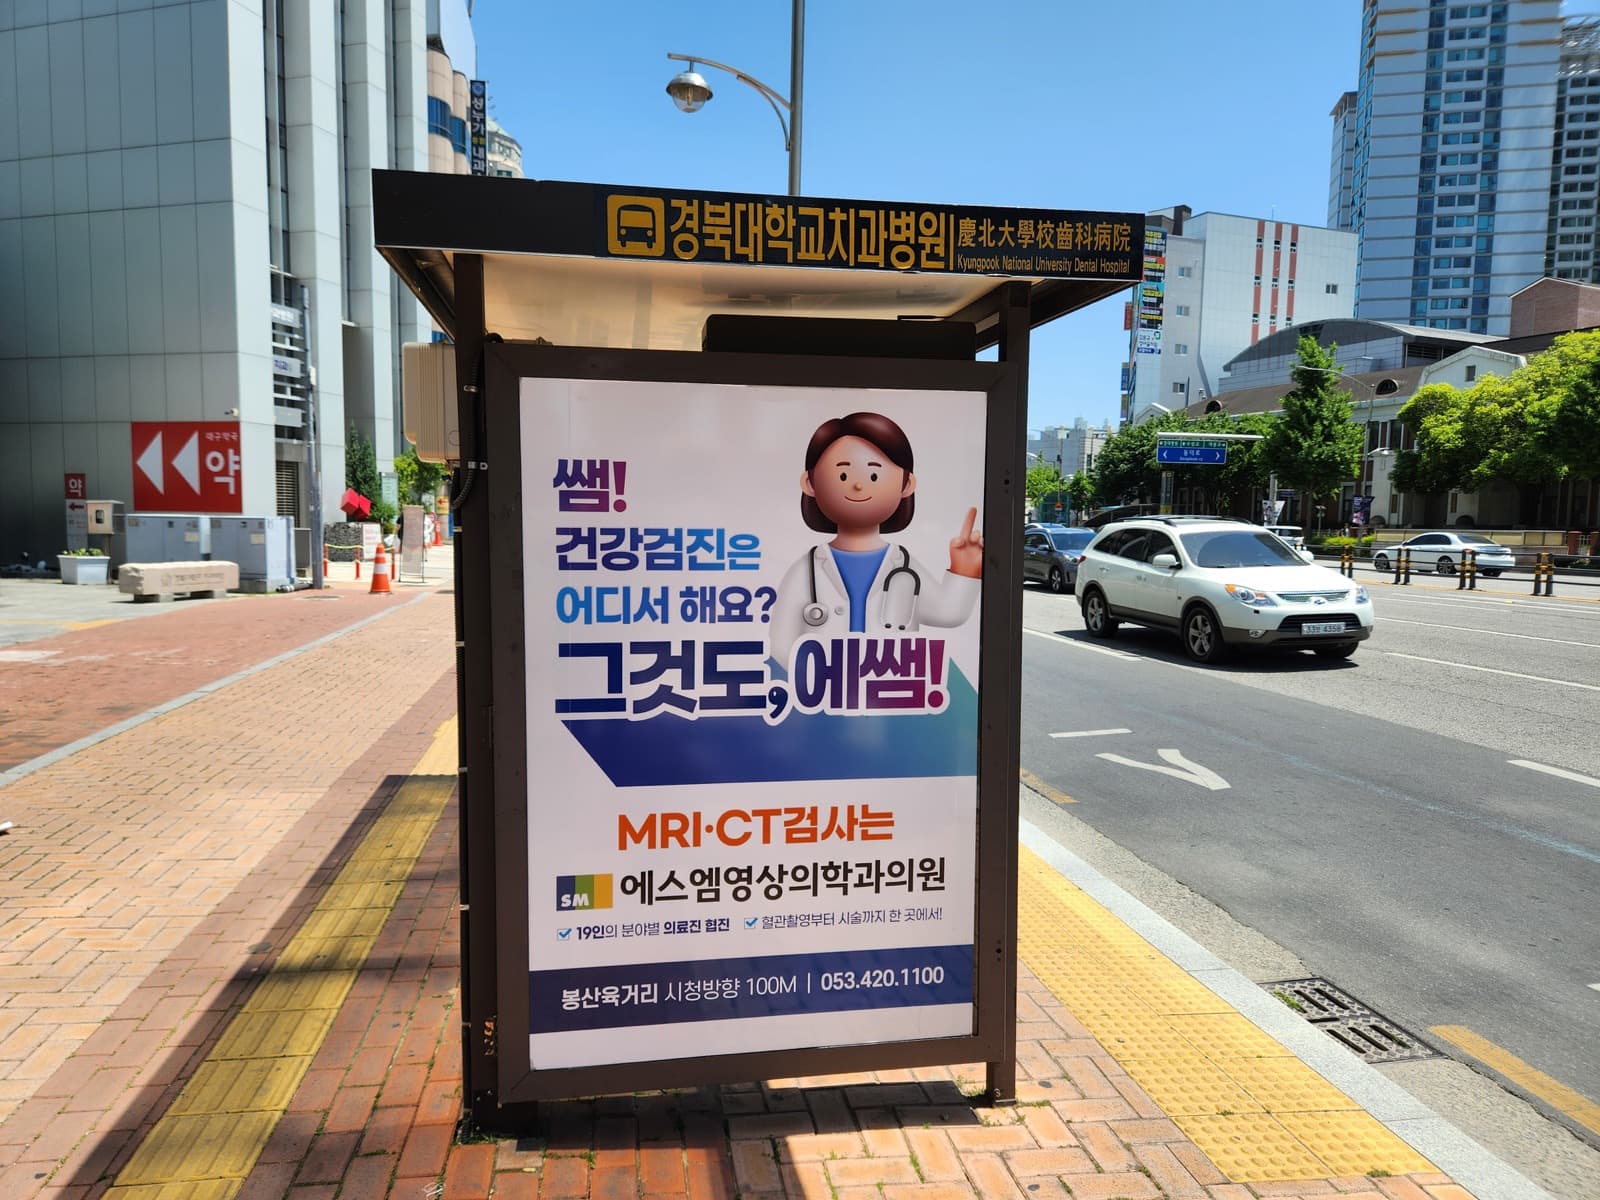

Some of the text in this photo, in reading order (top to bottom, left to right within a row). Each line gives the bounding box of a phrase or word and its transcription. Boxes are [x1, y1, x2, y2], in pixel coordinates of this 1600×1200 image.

[670, 199, 946, 269] 경북대학교치과병원
[957, 217, 1131, 252] 慶北大學校齒科病院
[957, 254, 999, 273] Kyungpook
[1002, 255, 1033, 271] National
[1035, 256, 1072, 275] University
[1074, 257, 1098, 273] Dental
[1100, 258, 1130, 275] Hospital
[69, 479, 82, 496] 약
[205, 448, 240, 495] 약
[553, 459, 627, 513] 쌤!
[556, 527, 761, 571] 건강검진은
[556, 586, 777, 624] 어디서 해요?
[794, 638, 945, 711] 에쌤!
[561, 893, 590, 907] SM
[620, 857, 946, 906] 에스엠영상의학과의원
[576, 918, 731, 940] 19인의 분야별 의료진 협진
[762, 907, 943, 929] 혈관촬영부터 시술까지 한 곳에서!
[561, 966, 945, 1011] 봉산육거리 시청방향 100M 053.420.1100
